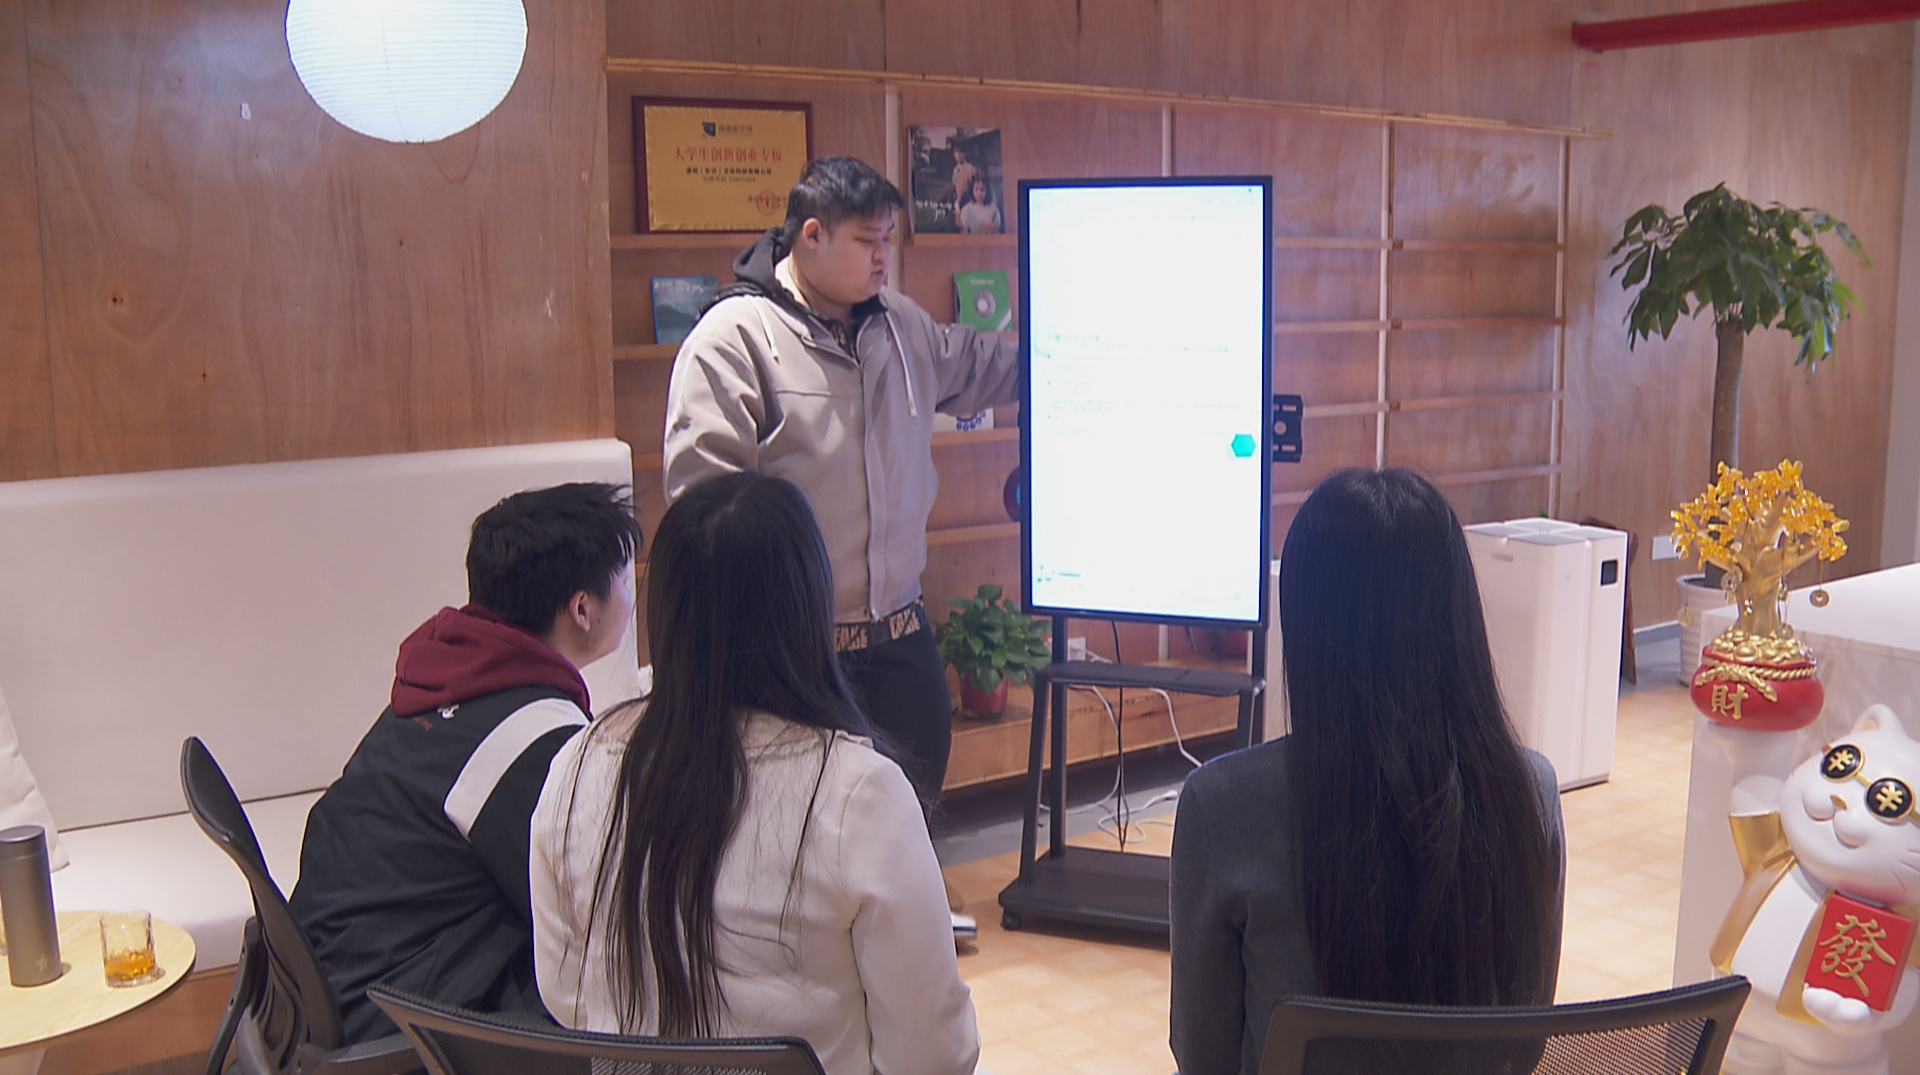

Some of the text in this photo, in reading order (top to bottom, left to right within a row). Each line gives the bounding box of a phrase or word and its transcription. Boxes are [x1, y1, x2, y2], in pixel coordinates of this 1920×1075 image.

[674, 146, 783, 162] 大学生创新创业专板
[1711, 683, 1750, 721] 財
[1818, 913, 1897, 998] 發
